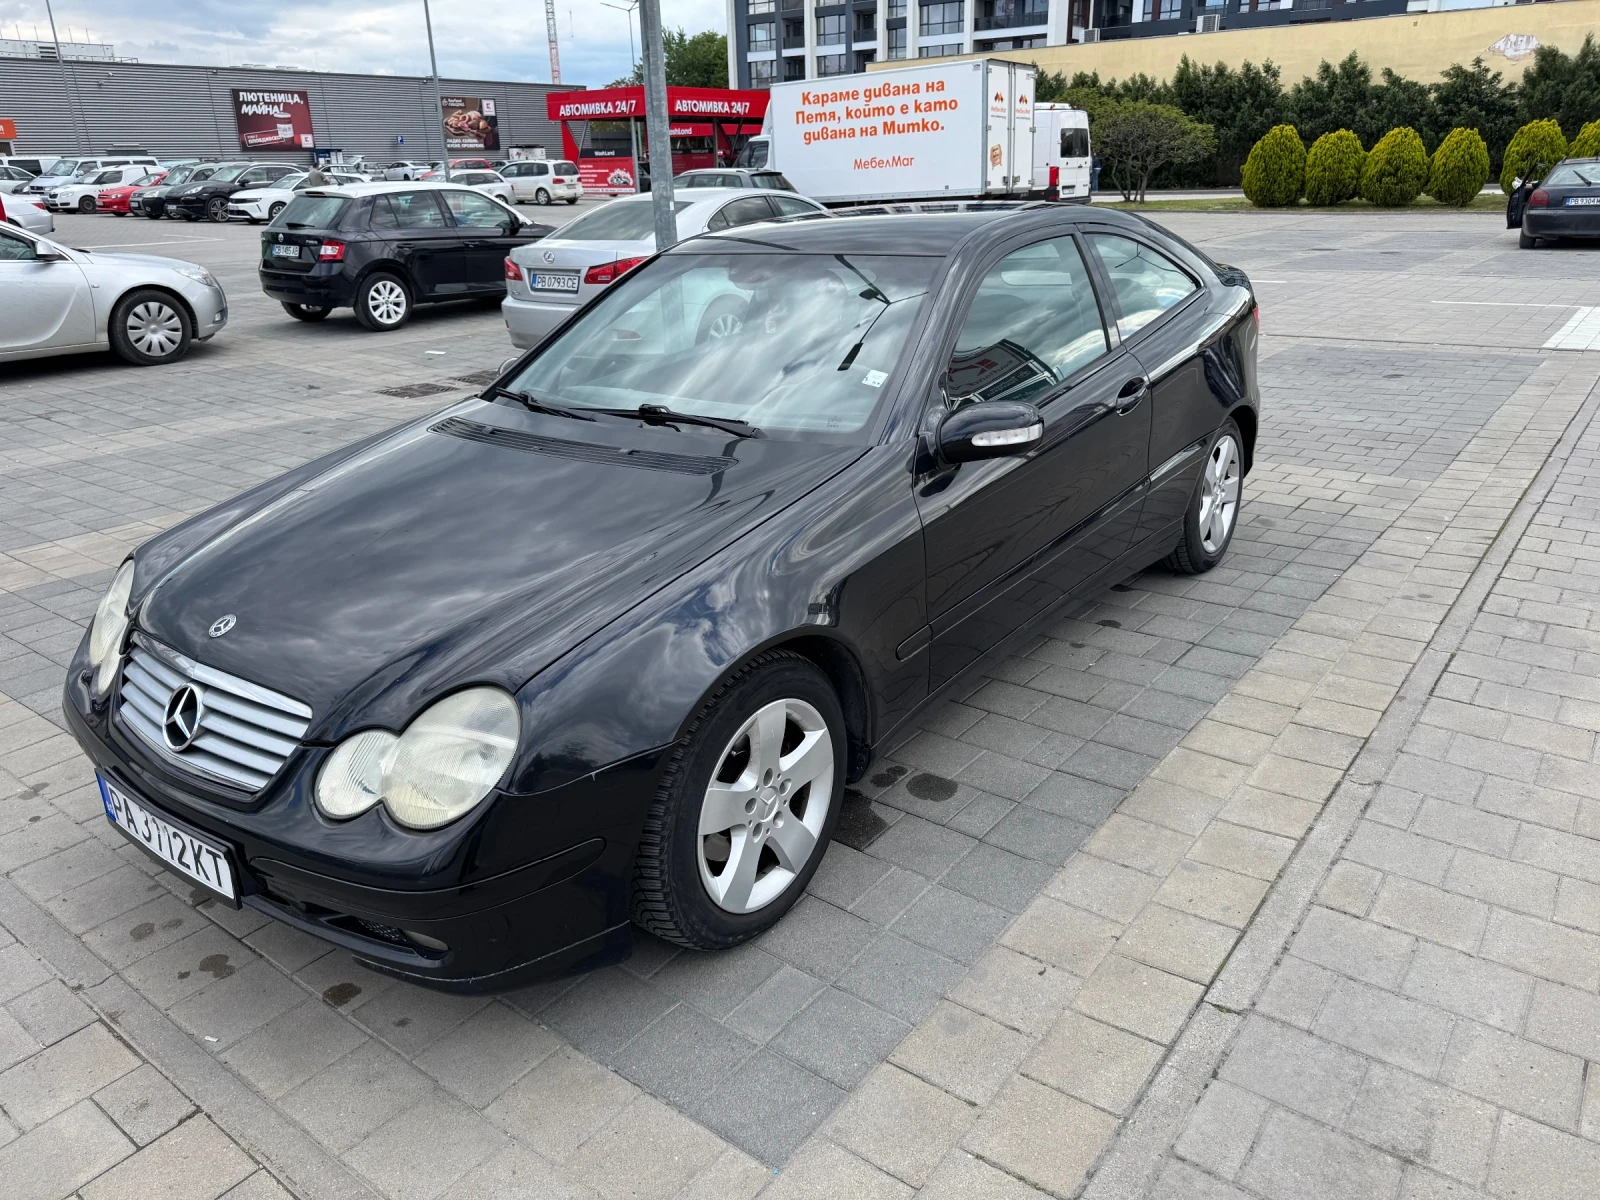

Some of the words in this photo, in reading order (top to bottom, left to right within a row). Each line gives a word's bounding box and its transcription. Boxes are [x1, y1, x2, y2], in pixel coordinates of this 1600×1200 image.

[239, 92, 303, 104] ЛЮТЕНИЦА,
[802, 90, 860, 107] Караме
[864, 82, 920, 102] дивана
[926, 80, 944, 92] на
[241, 102, 283, 116] МАЙНА!
[559, 102, 613, 116] АВТОМИВКА
[616, 100, 636, 114] 24/7
[675, 100, 730, 113] АВТОМИВКА
[731, 102, 750, 115] 24/7
[796, 111, 841, 124] Петя,
[846, 104, 895, 119] който
[900, 104, 908, 114] е
[914, 99, 958, 113] като
[803, 127, 855, 145] дивана
[860, 126, 877, 137] на
[883, 118, 944, 135] Митко.
[853, 156, 914, 170] МебелМаг
[548, 277, 565, 288] 0793
